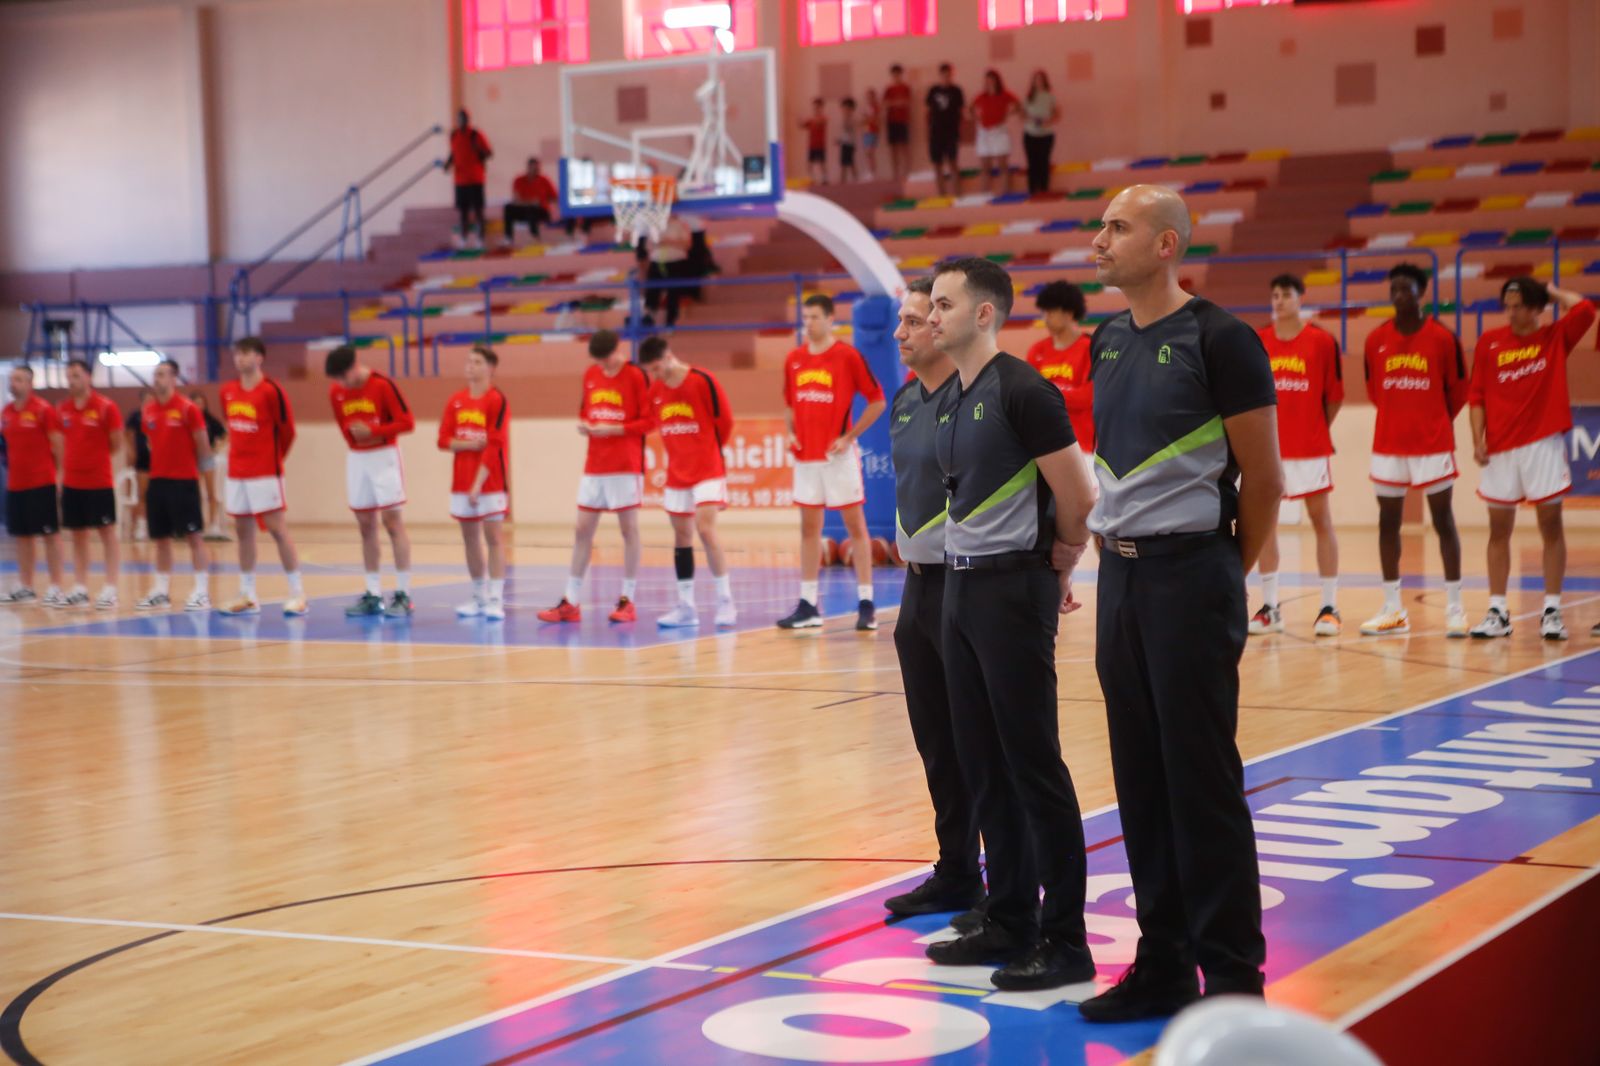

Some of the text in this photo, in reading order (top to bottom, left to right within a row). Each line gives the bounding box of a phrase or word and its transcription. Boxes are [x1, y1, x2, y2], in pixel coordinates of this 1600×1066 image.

[1271, 355, 1307, 374] SPAÑA
[1385, 352, 1428, 374] ESPAÑA
[1497, 344, 1542, 368] ESPAÑA
[1383, 376, 1431, 391] endesa
